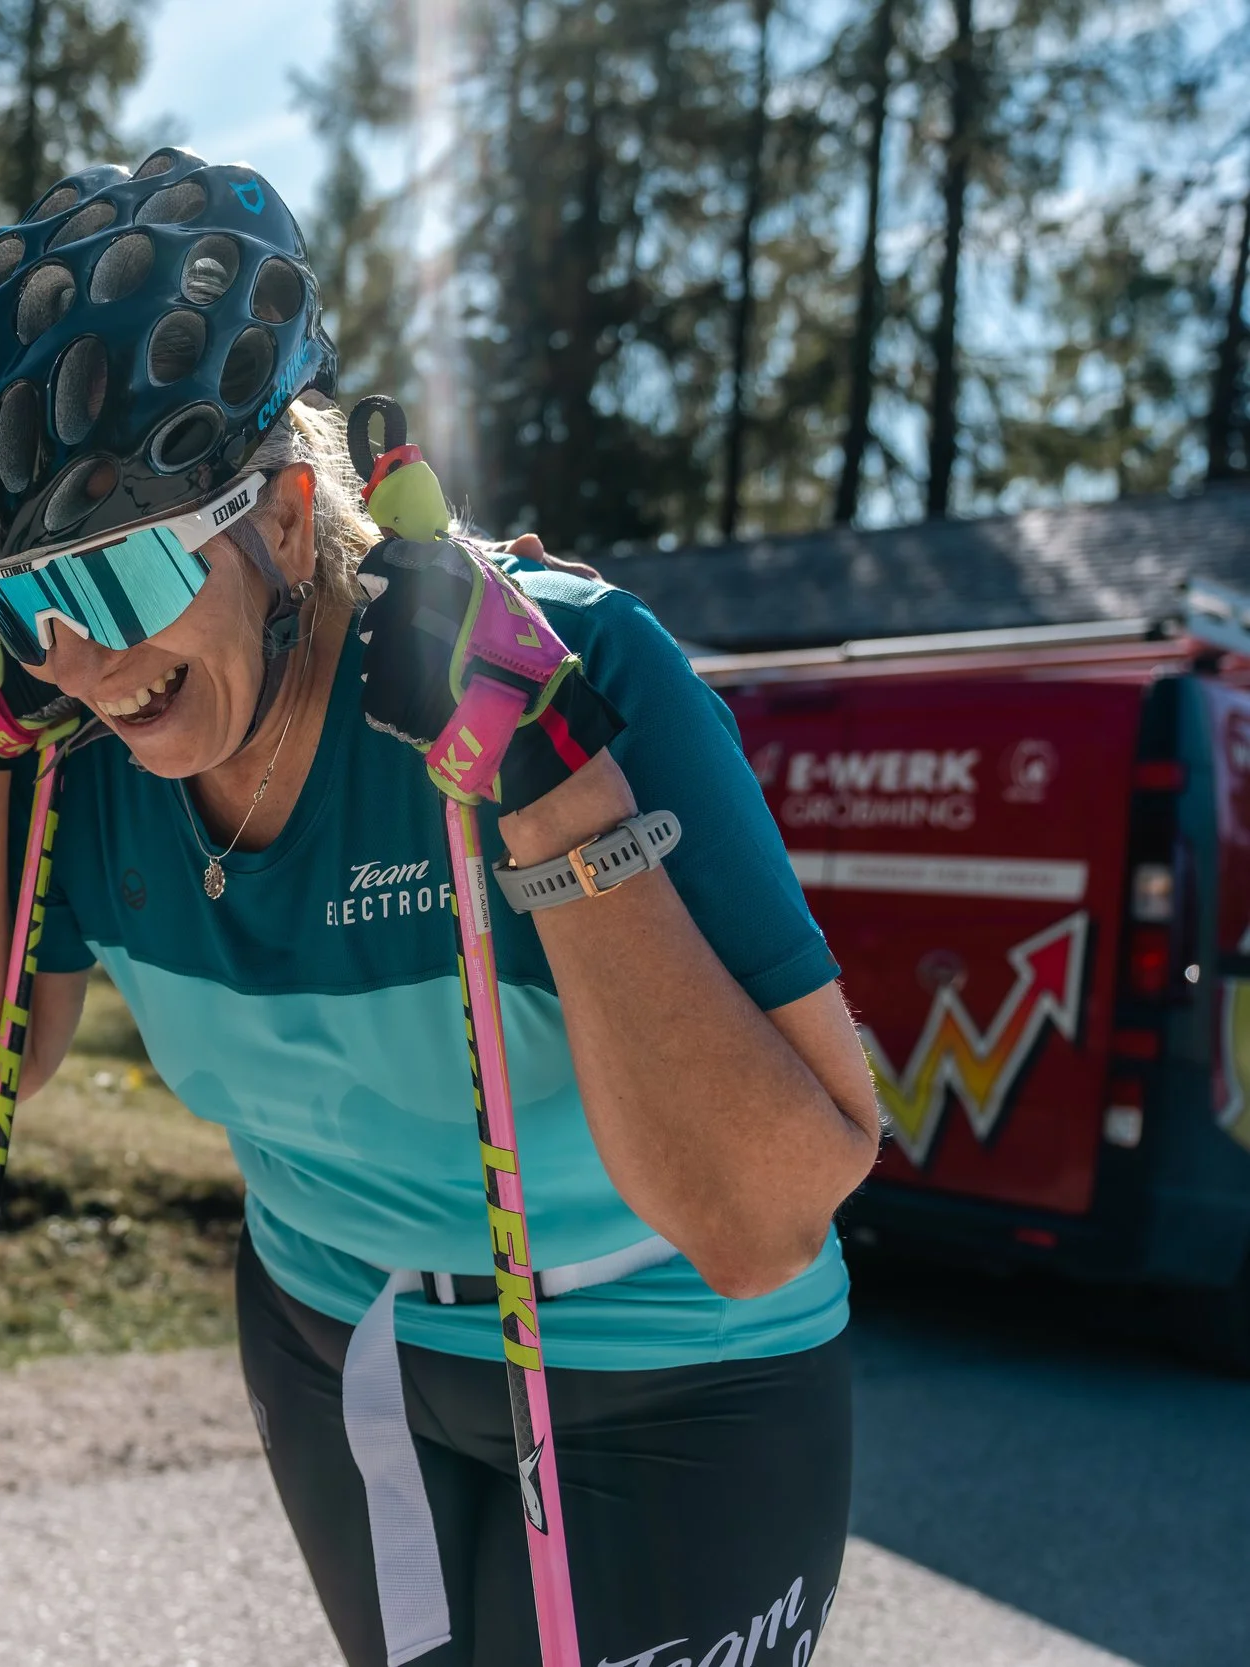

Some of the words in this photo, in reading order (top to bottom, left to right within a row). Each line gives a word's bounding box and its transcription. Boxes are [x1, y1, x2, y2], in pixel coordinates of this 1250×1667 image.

[786, 748, 982, 794] E-WERK
[350, 859, 431, 893] Team
[474, 863, 485, 890] PIRJO
[479, 892, 490, 929] LAUREN
[479, 1138, 541, 1372] LEKI
